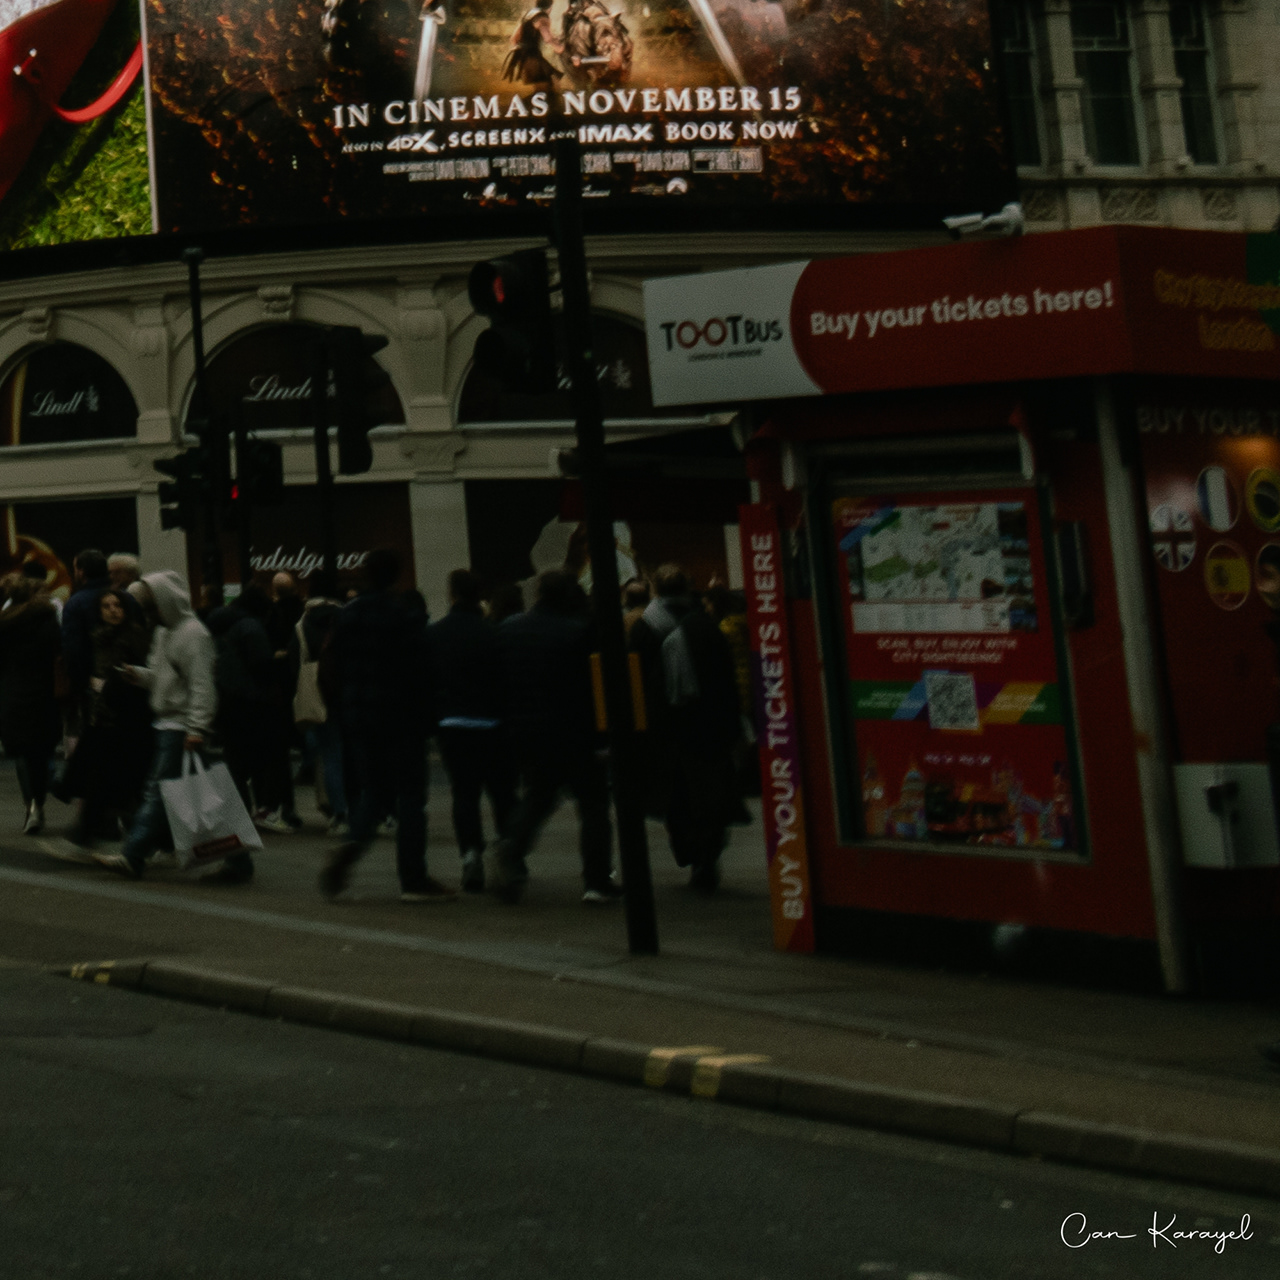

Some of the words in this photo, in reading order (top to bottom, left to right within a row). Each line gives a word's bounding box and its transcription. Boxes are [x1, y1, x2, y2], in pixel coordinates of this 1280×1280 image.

[333, 103, 370, 129] IN
[384, 92, 549, 124] CINEMAS
[563, 86, 763, 115] NOVEMBER
[769, 86, 801, 111] 15
[448, 127, 546, 148] SCREENX
[579, 123, 654, 143] IMAX
[665, 120, 735, 141] BOOK
[742, 120, 799, 140] NOW
[810, 310, 860, 340] Buy
[864, 304, 928, 339] your
[931, 293, 1029, 324] tickets
[1033, 280, 1114, 314] here!
[28, 389, 84, 417] Lindt
[751, 532, 779, 614] HERE
[758, 621, 790, 750] TICKETS
[770, 757, 798, 848] YOUR
[779, 854, 804, 920] BUY
